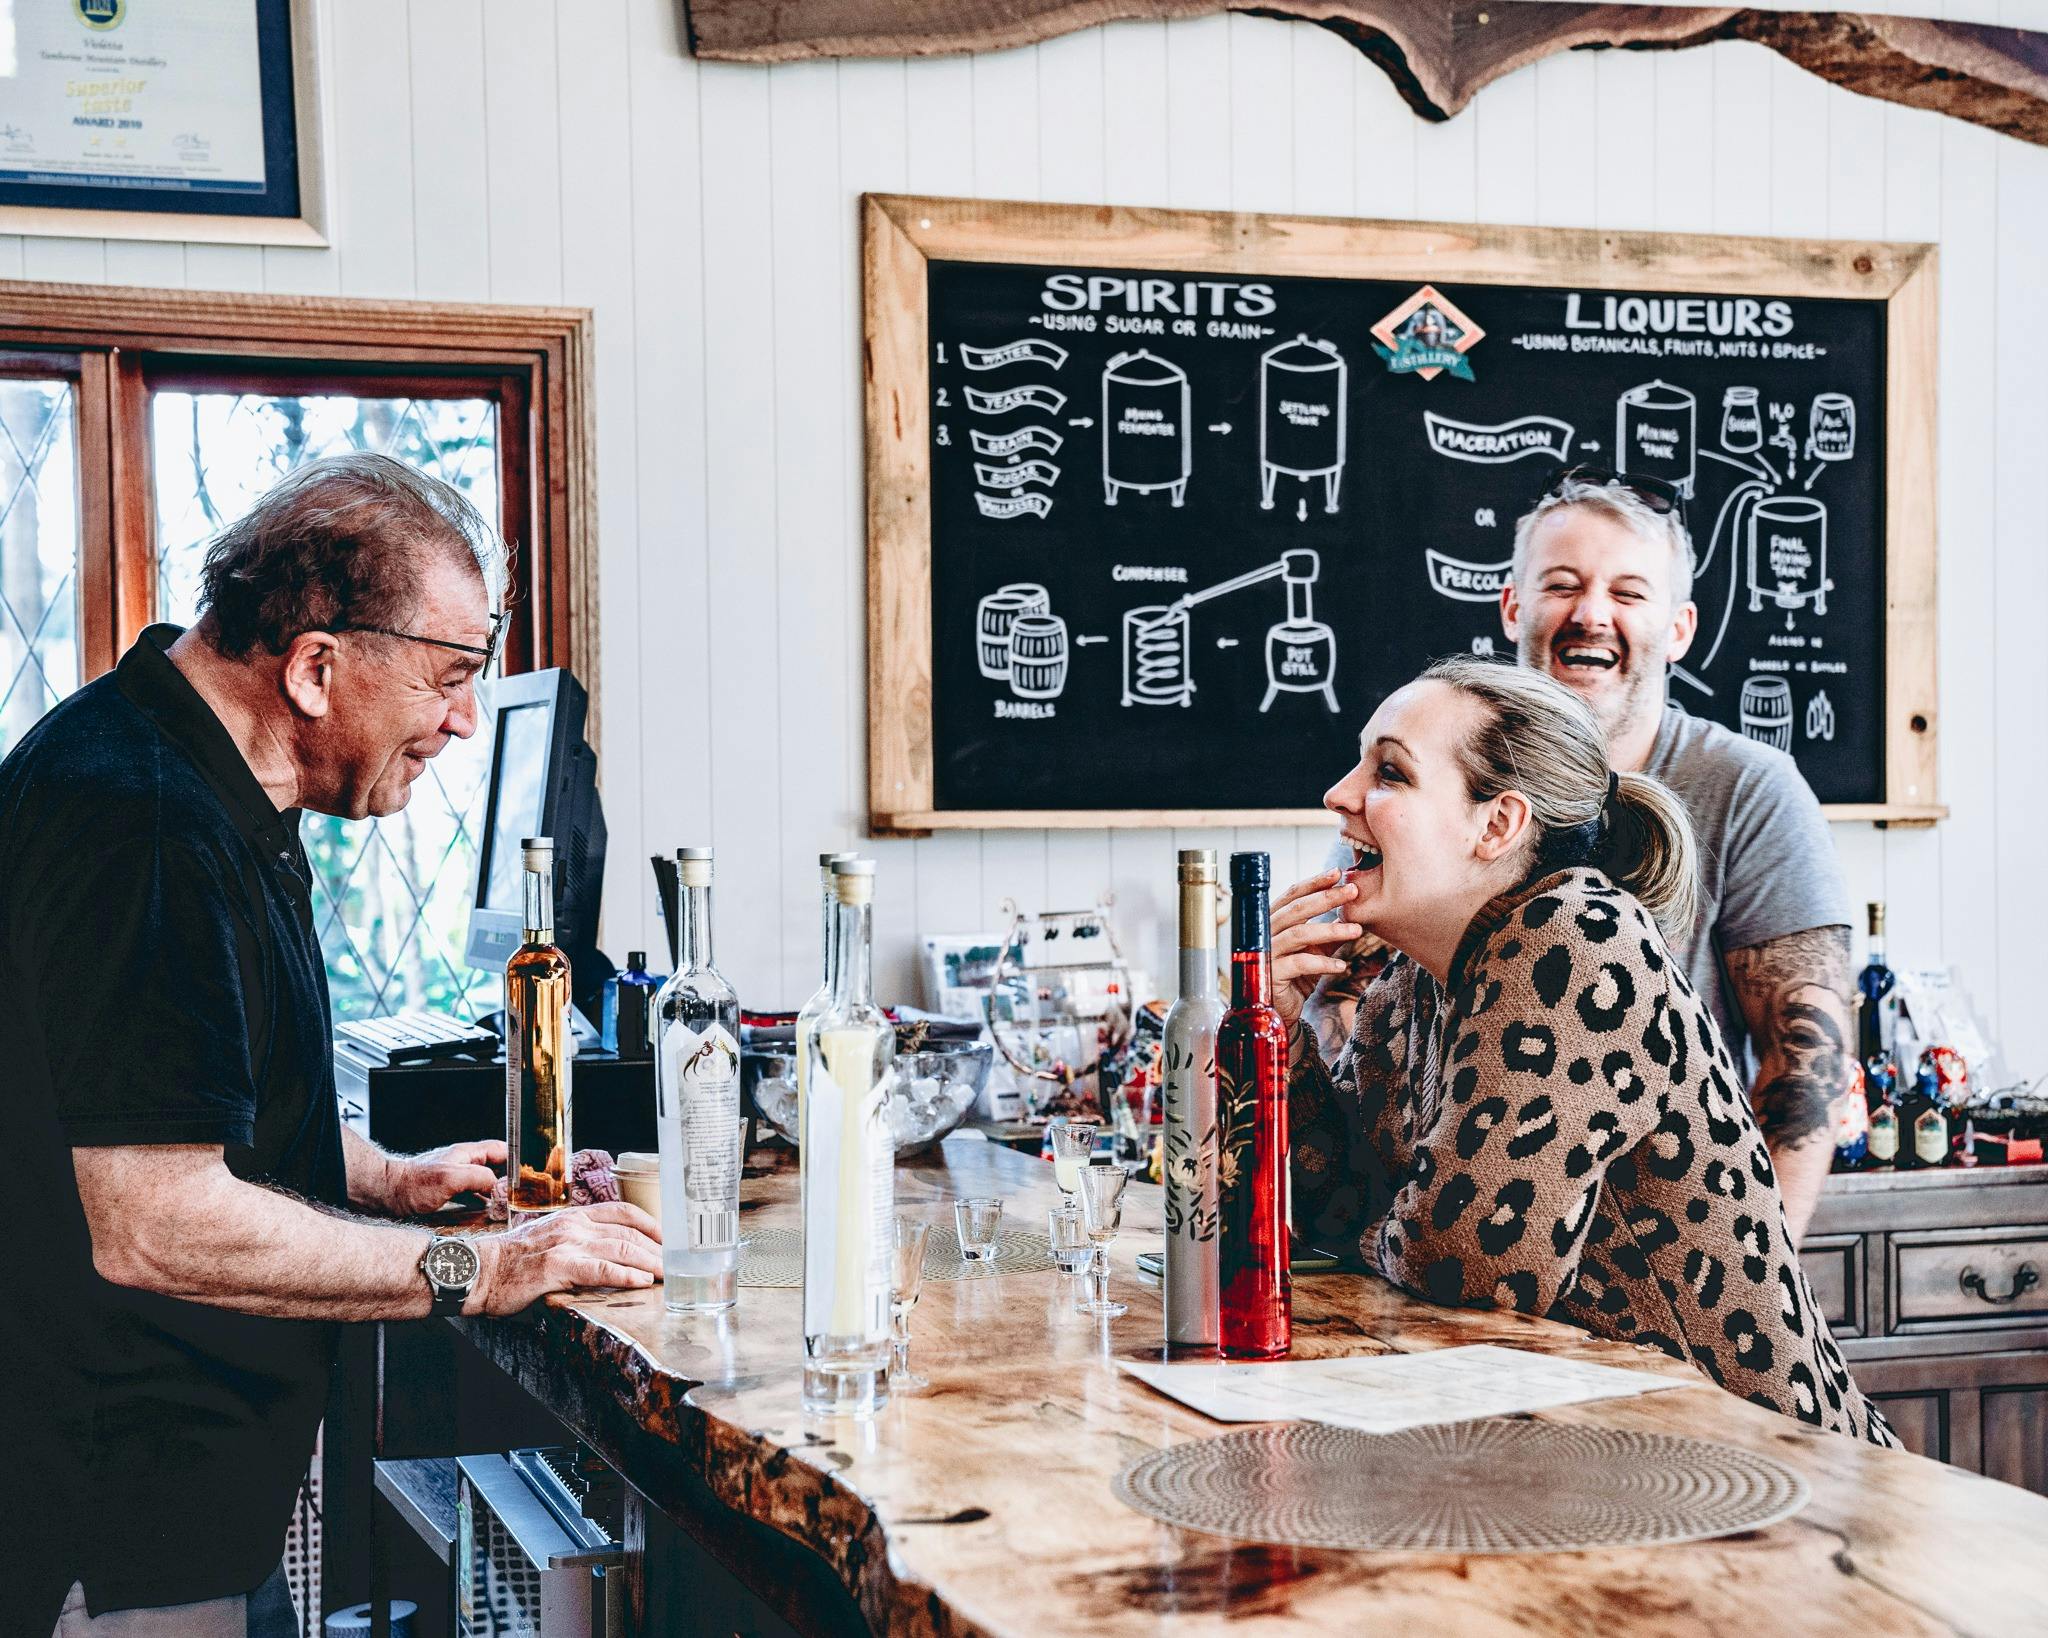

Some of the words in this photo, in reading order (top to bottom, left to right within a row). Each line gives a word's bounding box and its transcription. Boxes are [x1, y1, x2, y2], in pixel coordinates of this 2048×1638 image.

[72, 116, 115, 128] AWARD
[1041, 274, 1277, 317] SPIRITS
[1565, 293, 1794, 337] LIQUEURS
[1105, 315, 1165, 335] SUGAR
[1172, 319, 1197, 337] OR
[981, 344, 1034, 366] WATER
[1719, 340, 1758, 358] NUTS
[983, 390, 1036, 410] YEAST
[987, 430, 1034, 453] GRAIN
[1437, 426, 1552, 453] MACERATION
[1636, 421, 1680, 444] MIXING
[1640, 442, 1675, 460] TANK
[991, 464, 1040, 485] SUGAR
[1475, 508, 1497, 528] OR
[1770, 534, 1807, 552] FINAL
[1112, 565, 1188, 583] CONDENSER
[1287, 646, 1312, 662] POT
[1472, 636, 1494, 656] OR
[1281, 661, 1318, 676] STILL
[994, 700, 1056, 719] BARRELS
